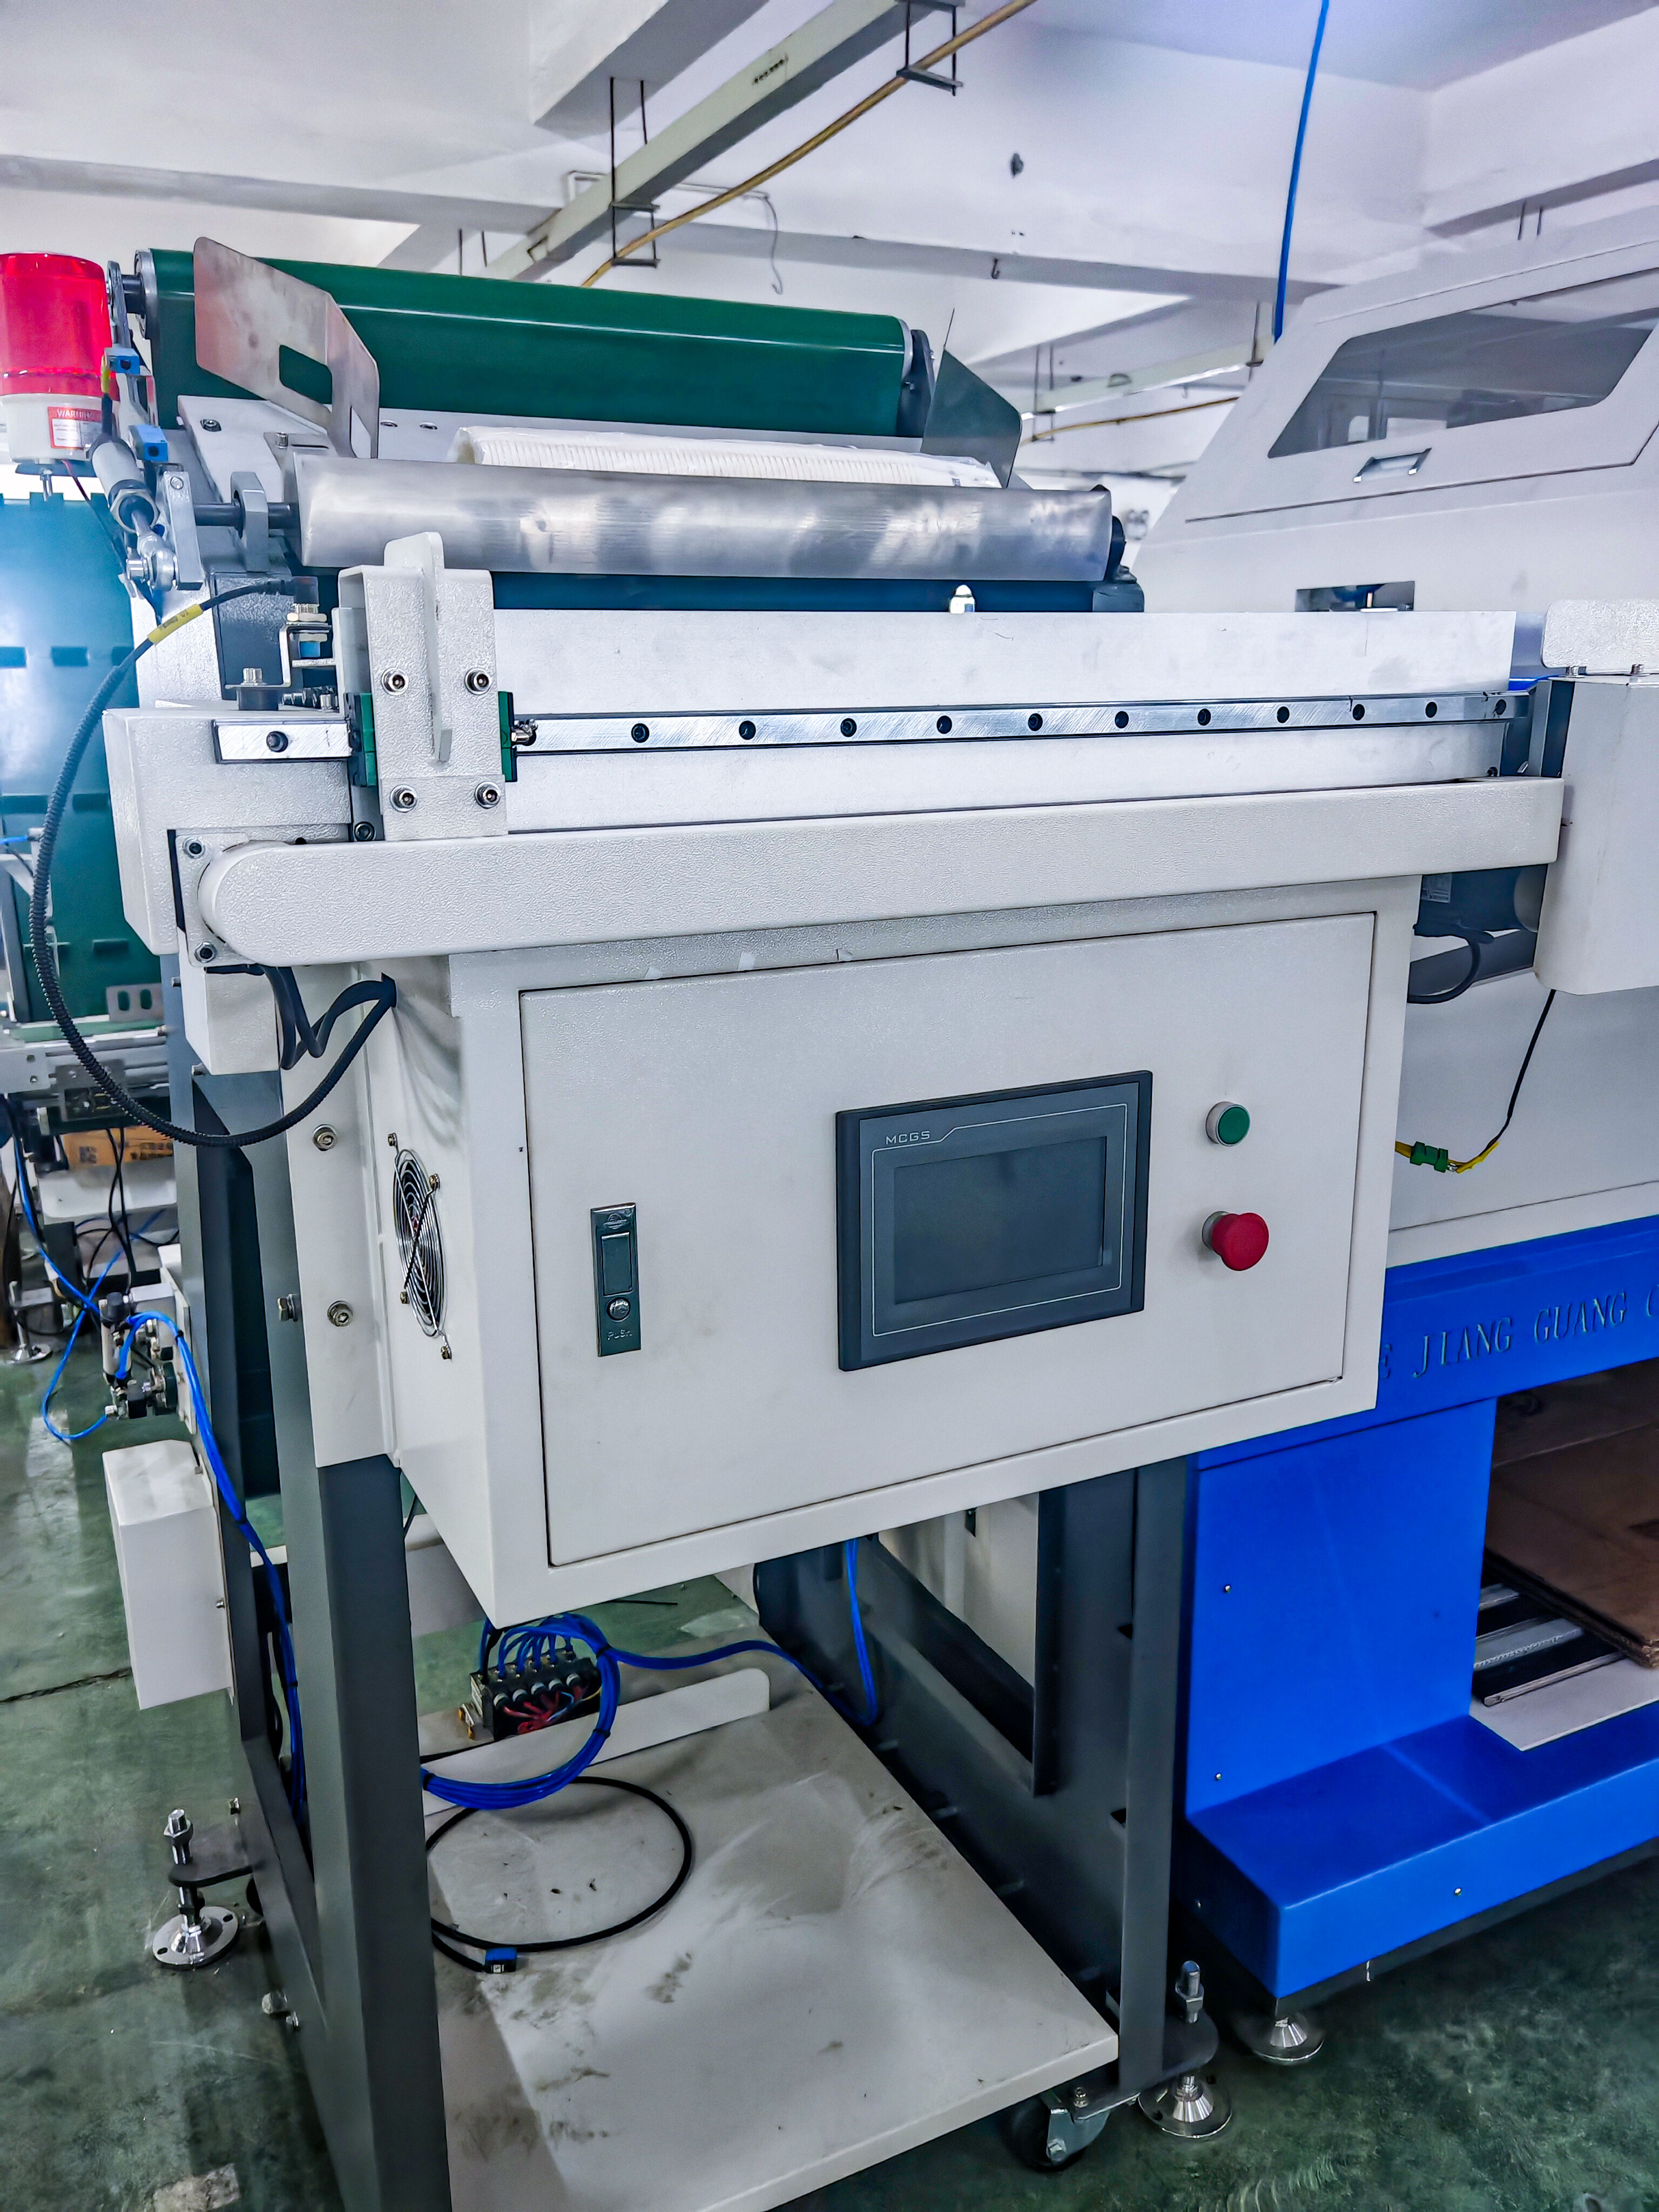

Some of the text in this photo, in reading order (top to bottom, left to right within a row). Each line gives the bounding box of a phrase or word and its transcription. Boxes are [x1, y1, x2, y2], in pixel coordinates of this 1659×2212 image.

[56, 408, 95, 419] WARNING
[885, 1130, 930, 1145] MCGS
[1412, 1317, 1512, 1379] JIANG
[1534, 1292, 1627, 1344] GUANG
